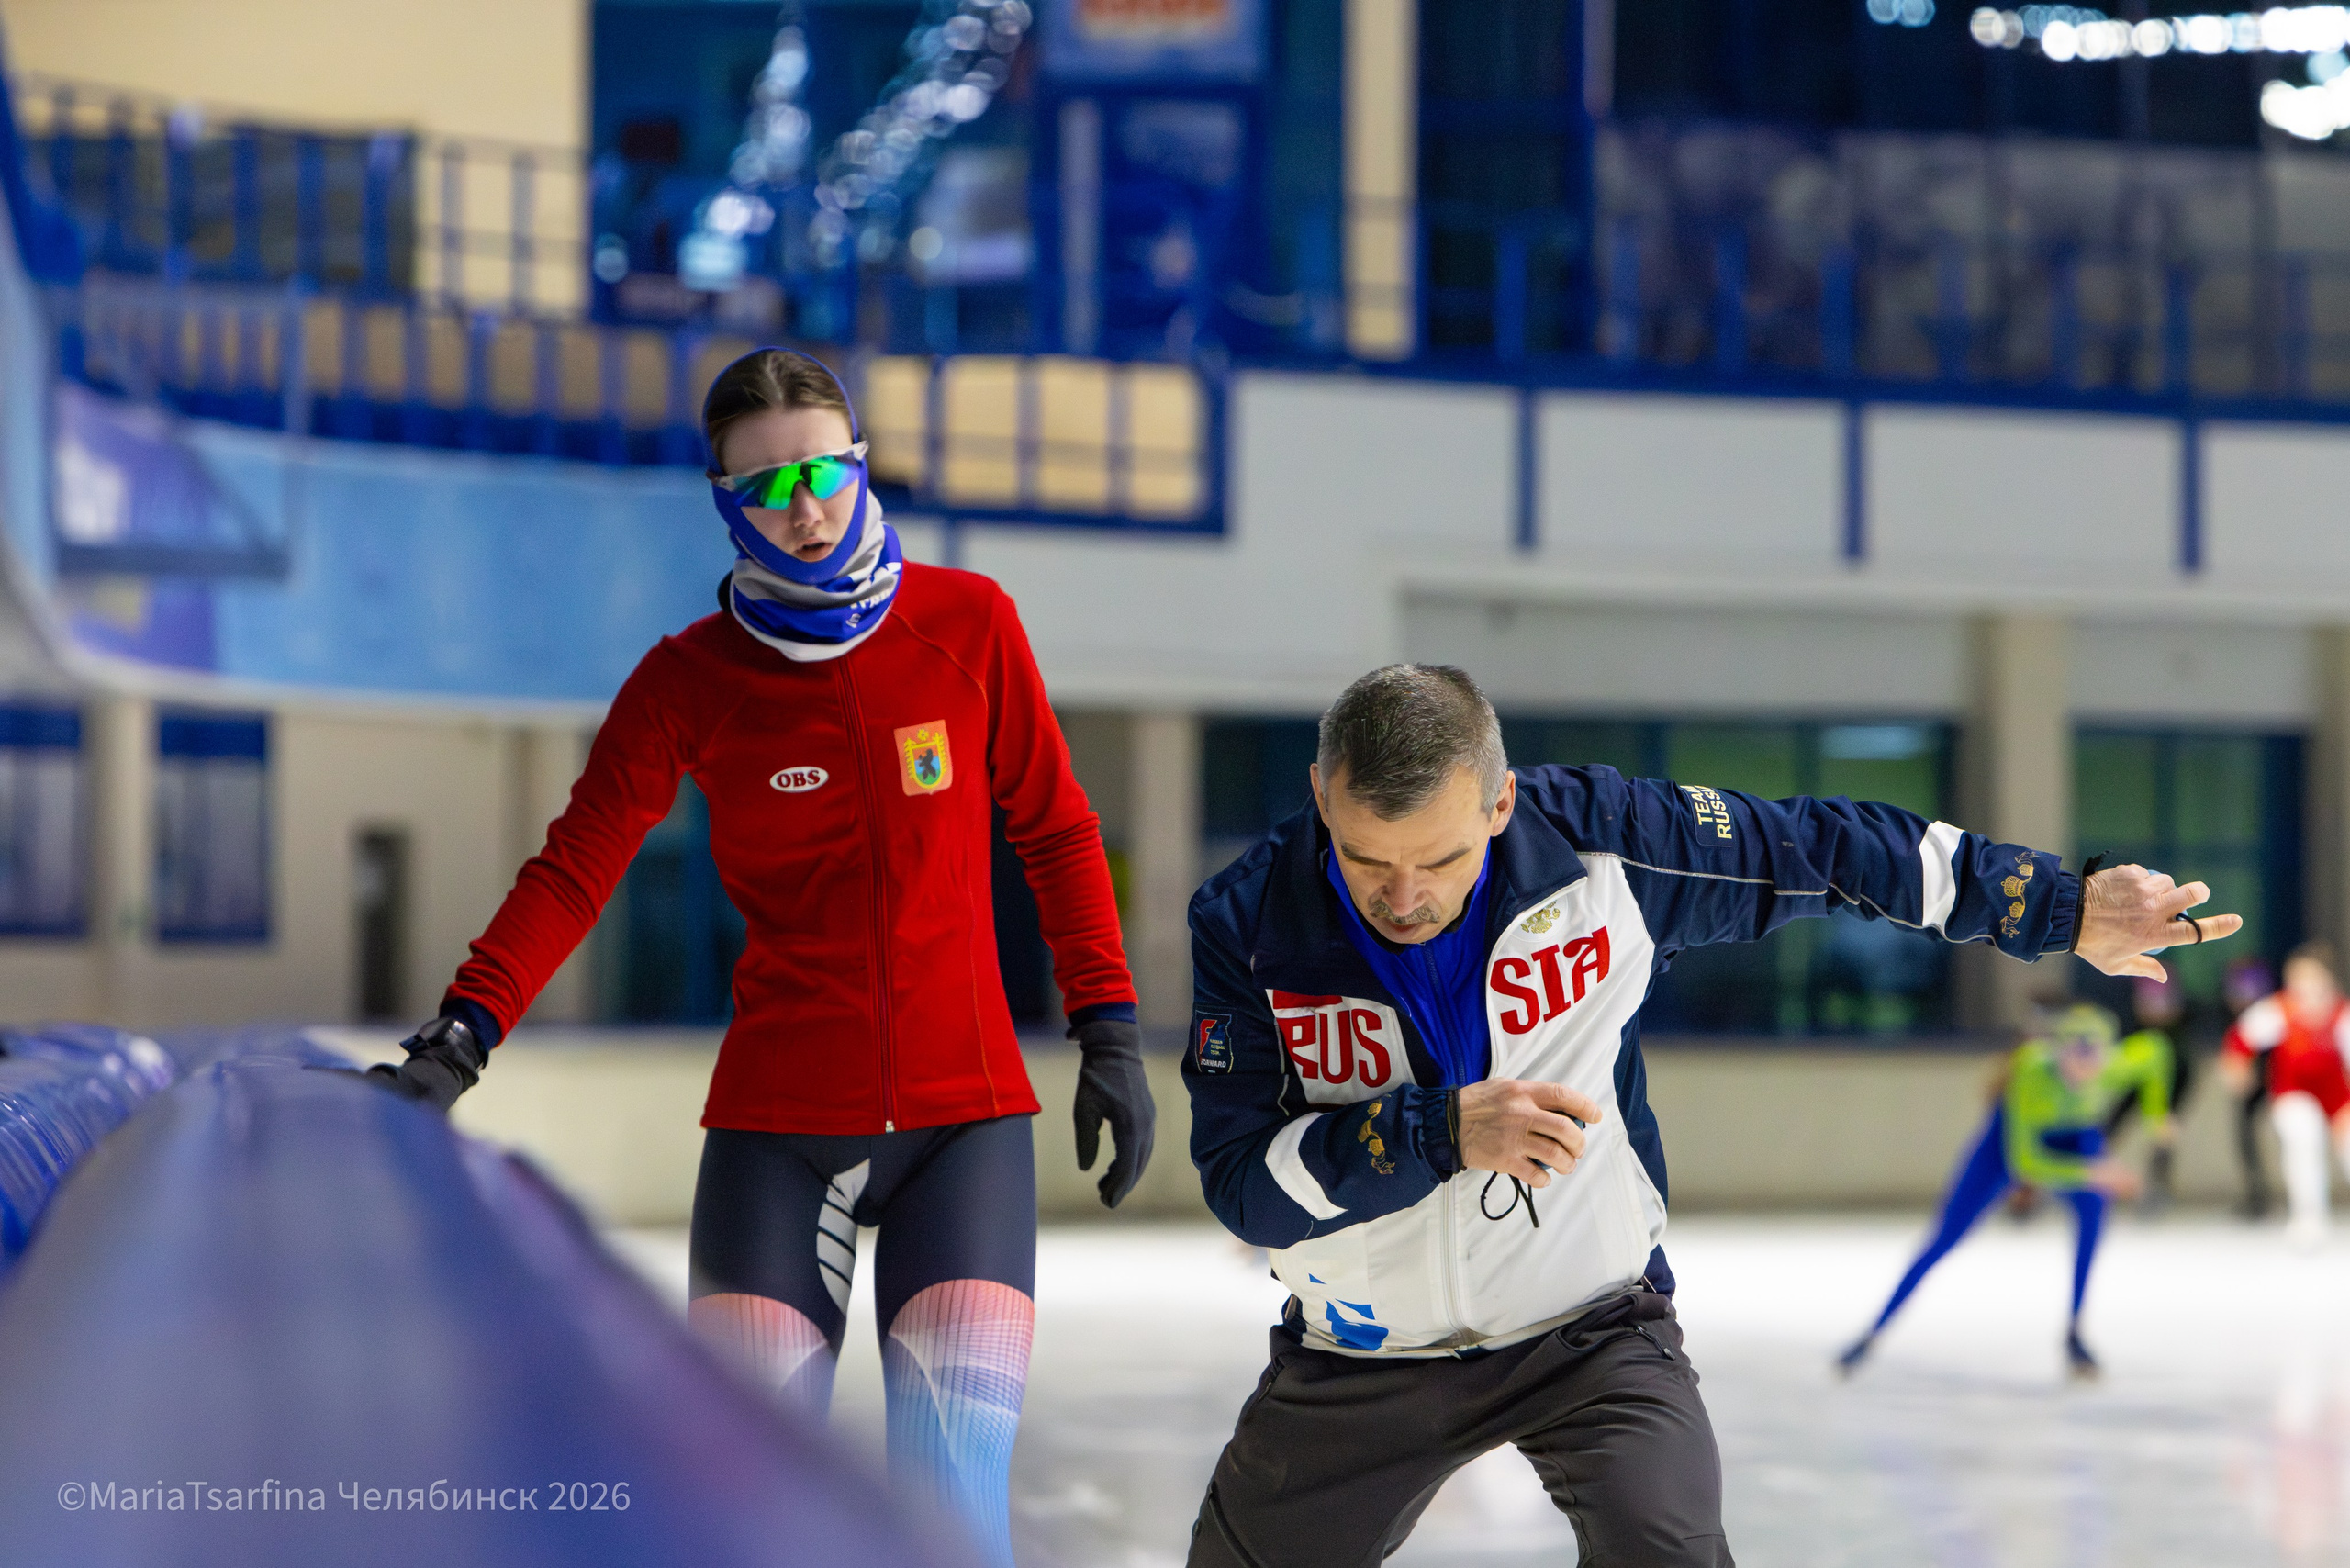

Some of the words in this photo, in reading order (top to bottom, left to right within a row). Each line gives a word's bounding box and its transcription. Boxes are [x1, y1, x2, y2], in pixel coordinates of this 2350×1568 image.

[776, 769, 821, 788] OBS
[1273, 989, 1392, 1089] RUS
[1490, 925, 1611, 1036] SIA
